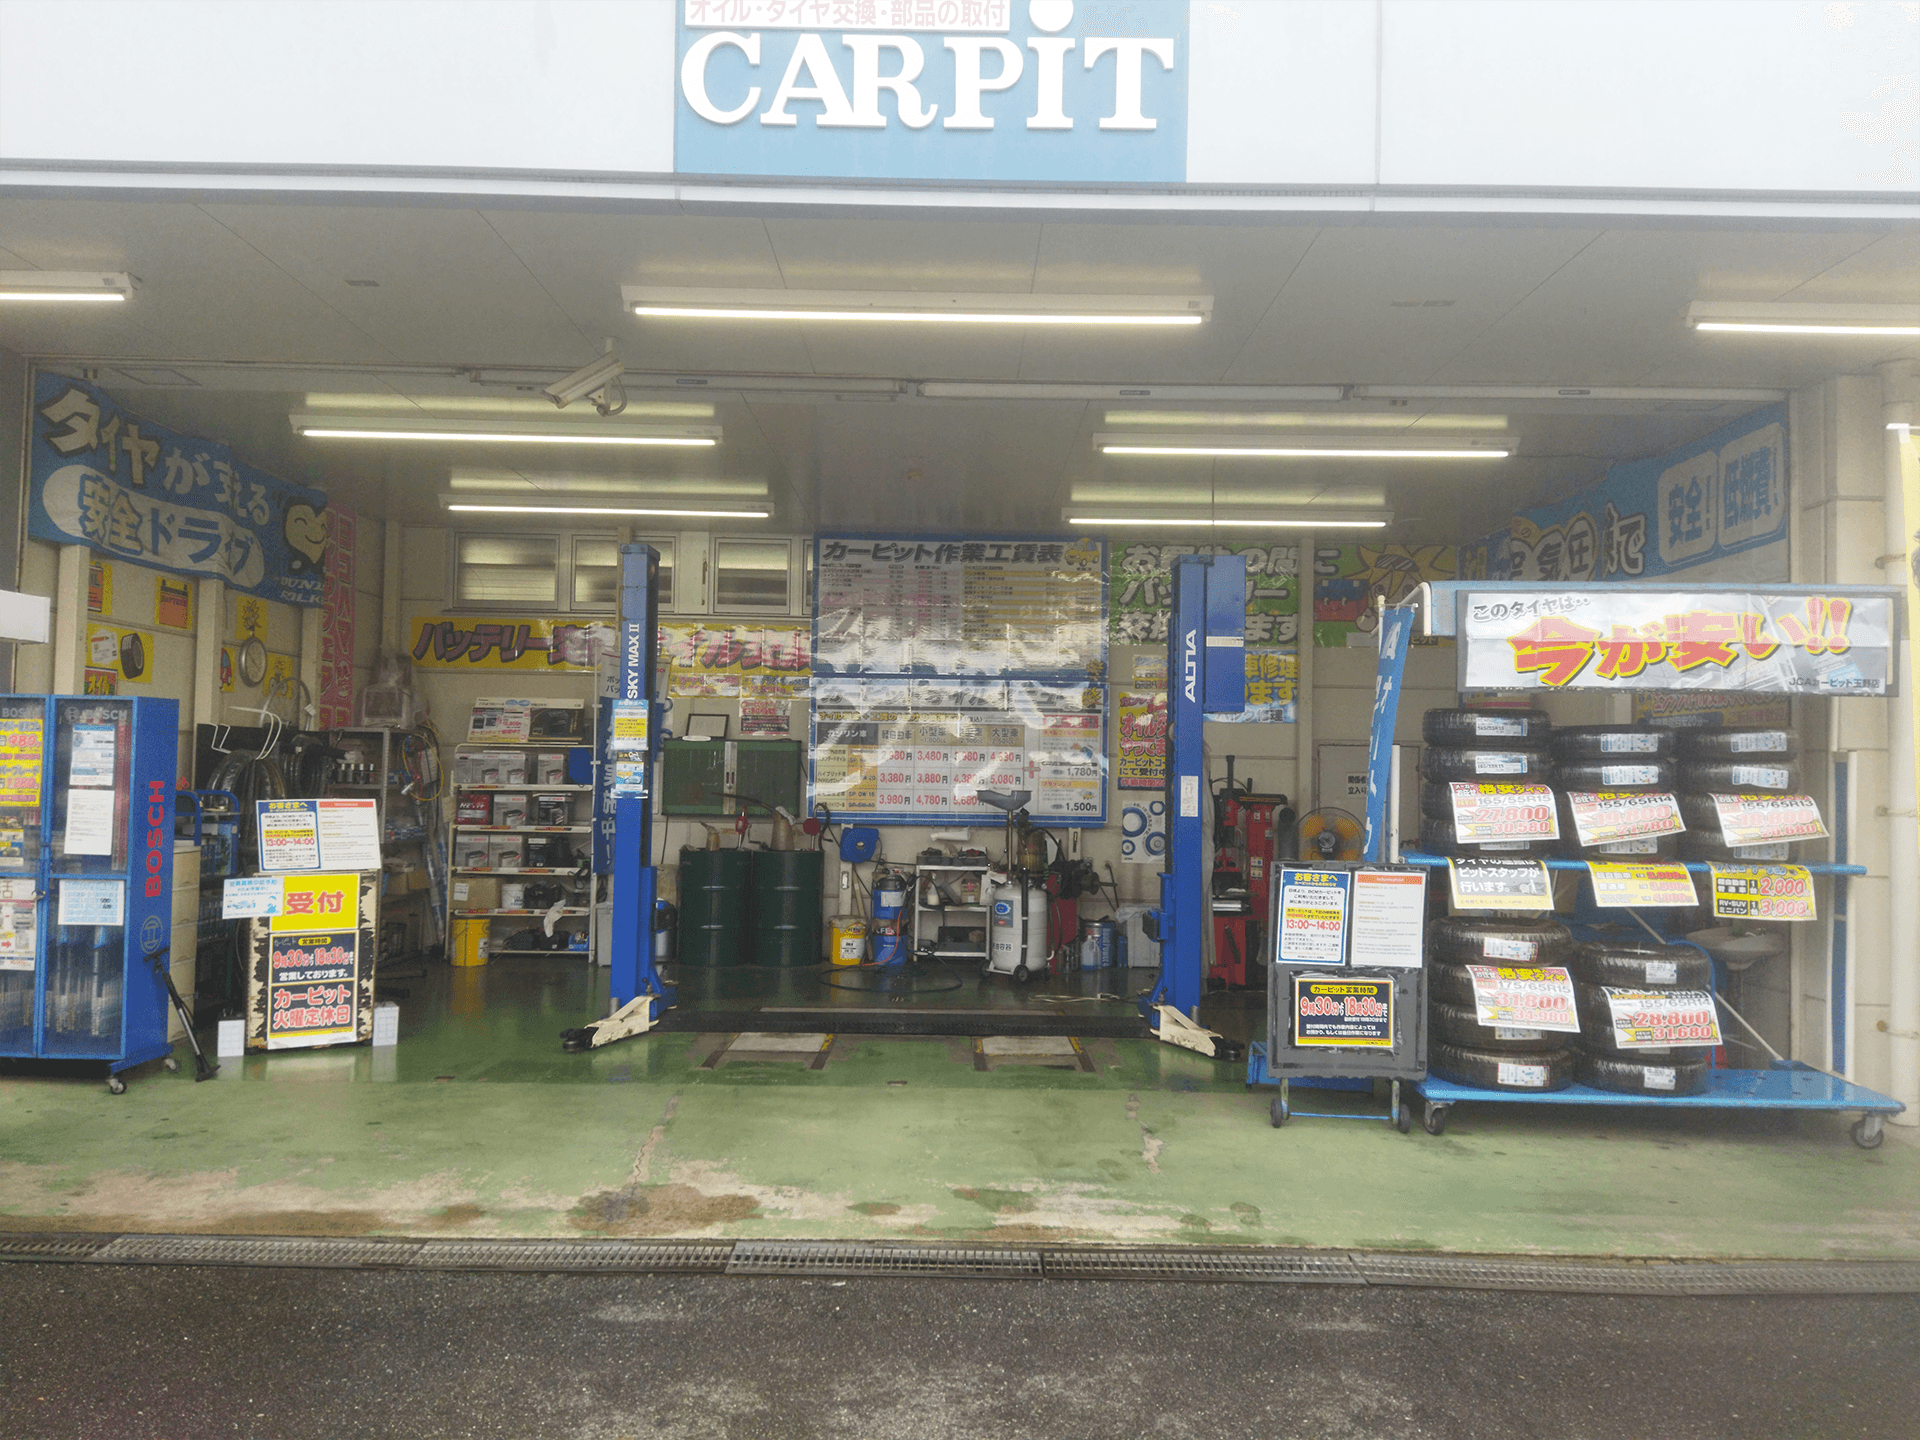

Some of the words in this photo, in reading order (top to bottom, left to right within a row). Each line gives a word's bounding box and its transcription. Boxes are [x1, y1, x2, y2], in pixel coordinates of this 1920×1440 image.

[822, 540, 1065, 565] カーピット作業工賃表
[628, 637, 640, 668] MAX
[627, 669, 639, 700] SKY
[1477, 795, 1552, 805] 165/55R15
[1597, 795, 1673, 809] 155/65R14
[1741, 799, 1814, 810] 155/65R13
[144, 780, 165, 899] BOSCH
[1294, 872, 1338, 882] お客さまへ
[1458, 867, 1540, 878] ピットスタッフが
[1460, 881, 1511, 893] 行います。
[285, 890, 345, 915] 受付
[278, 968, 349, 982] 営業しております。
[1498, 980, 1572, 994] 175/65R15
[273, 984, 351, 1009] カーピット
[1639, 998, 1711, 1008] 155/65R14
[272, 1004, 351, 1030] 火曜定休日
[1633, 1010, 1711, 1027] 28,800
[1653, 1026, 1712, 1041] 31,680
